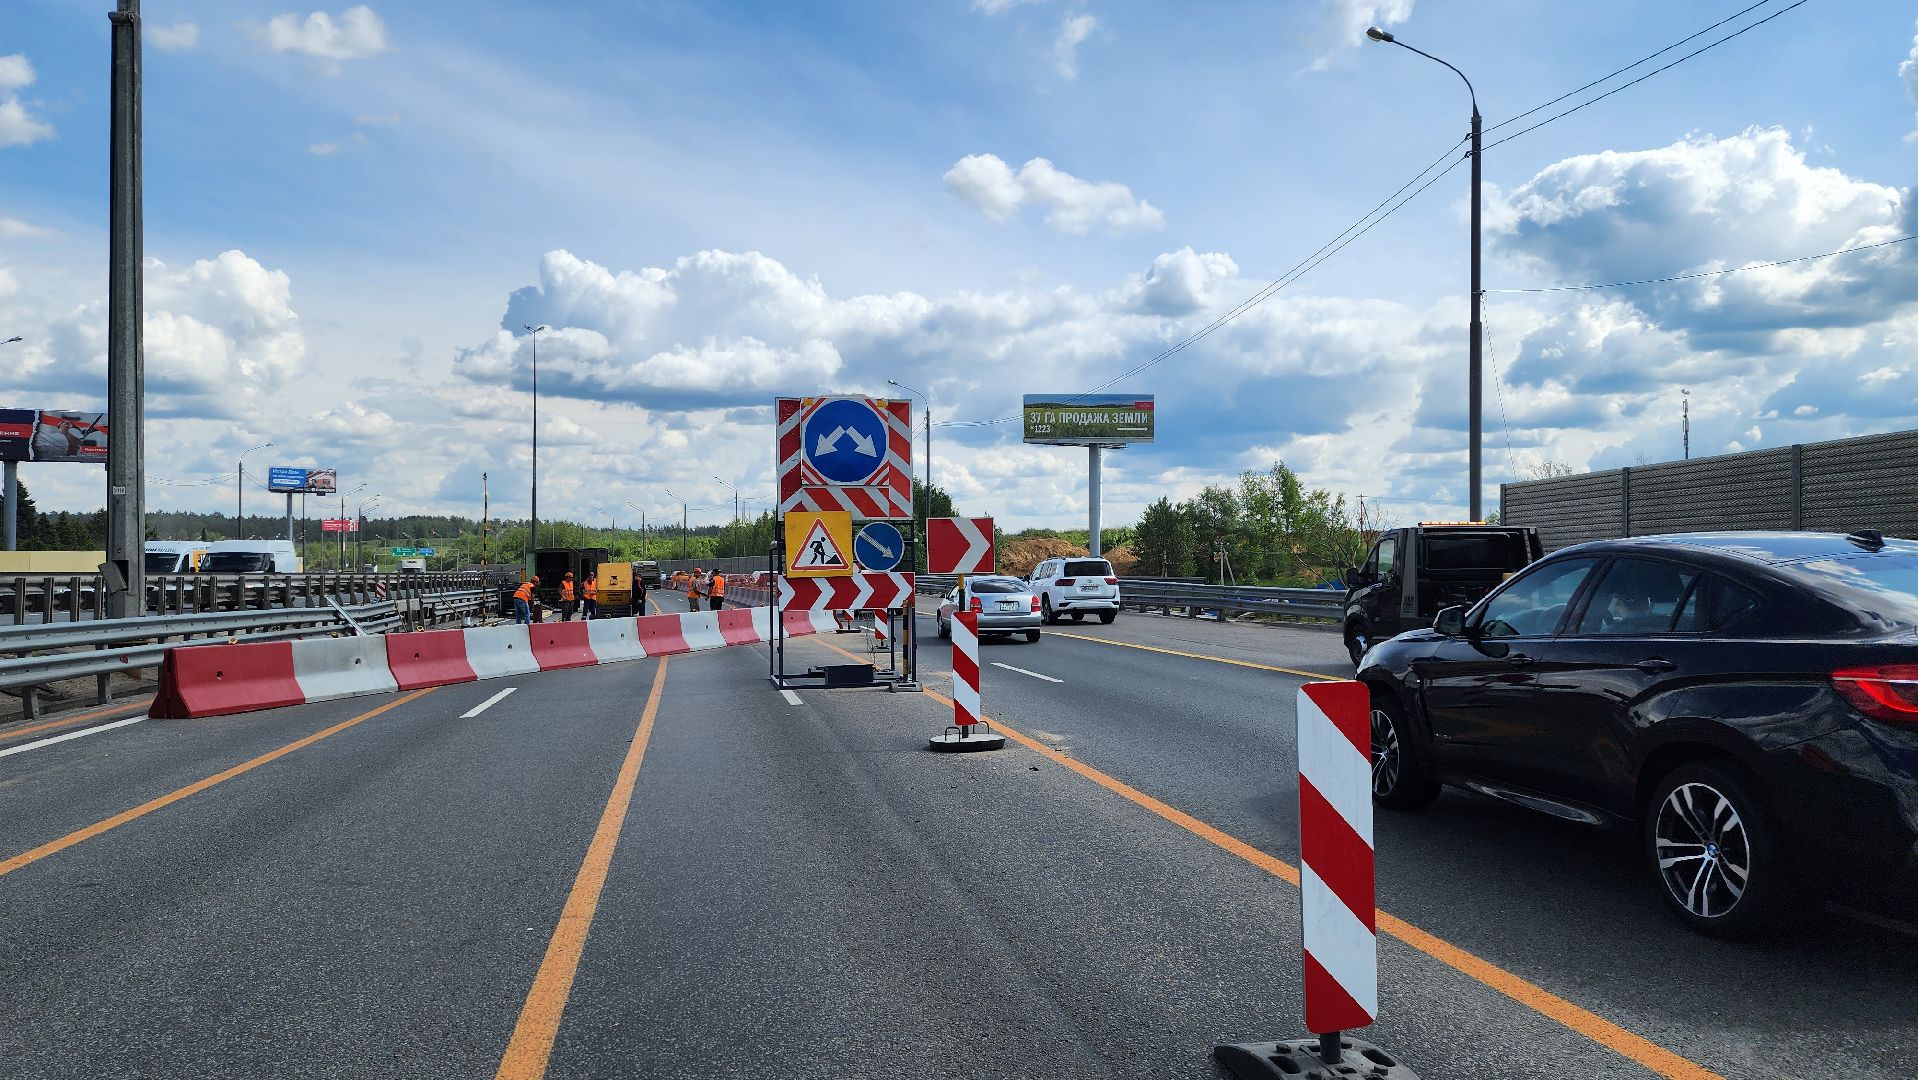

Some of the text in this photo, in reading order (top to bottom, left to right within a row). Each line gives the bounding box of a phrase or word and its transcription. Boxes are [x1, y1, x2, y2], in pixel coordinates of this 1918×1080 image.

[1030, 412, 1148, 425] 37 ГА ПРОДАЖА ЗЕМЛИ
